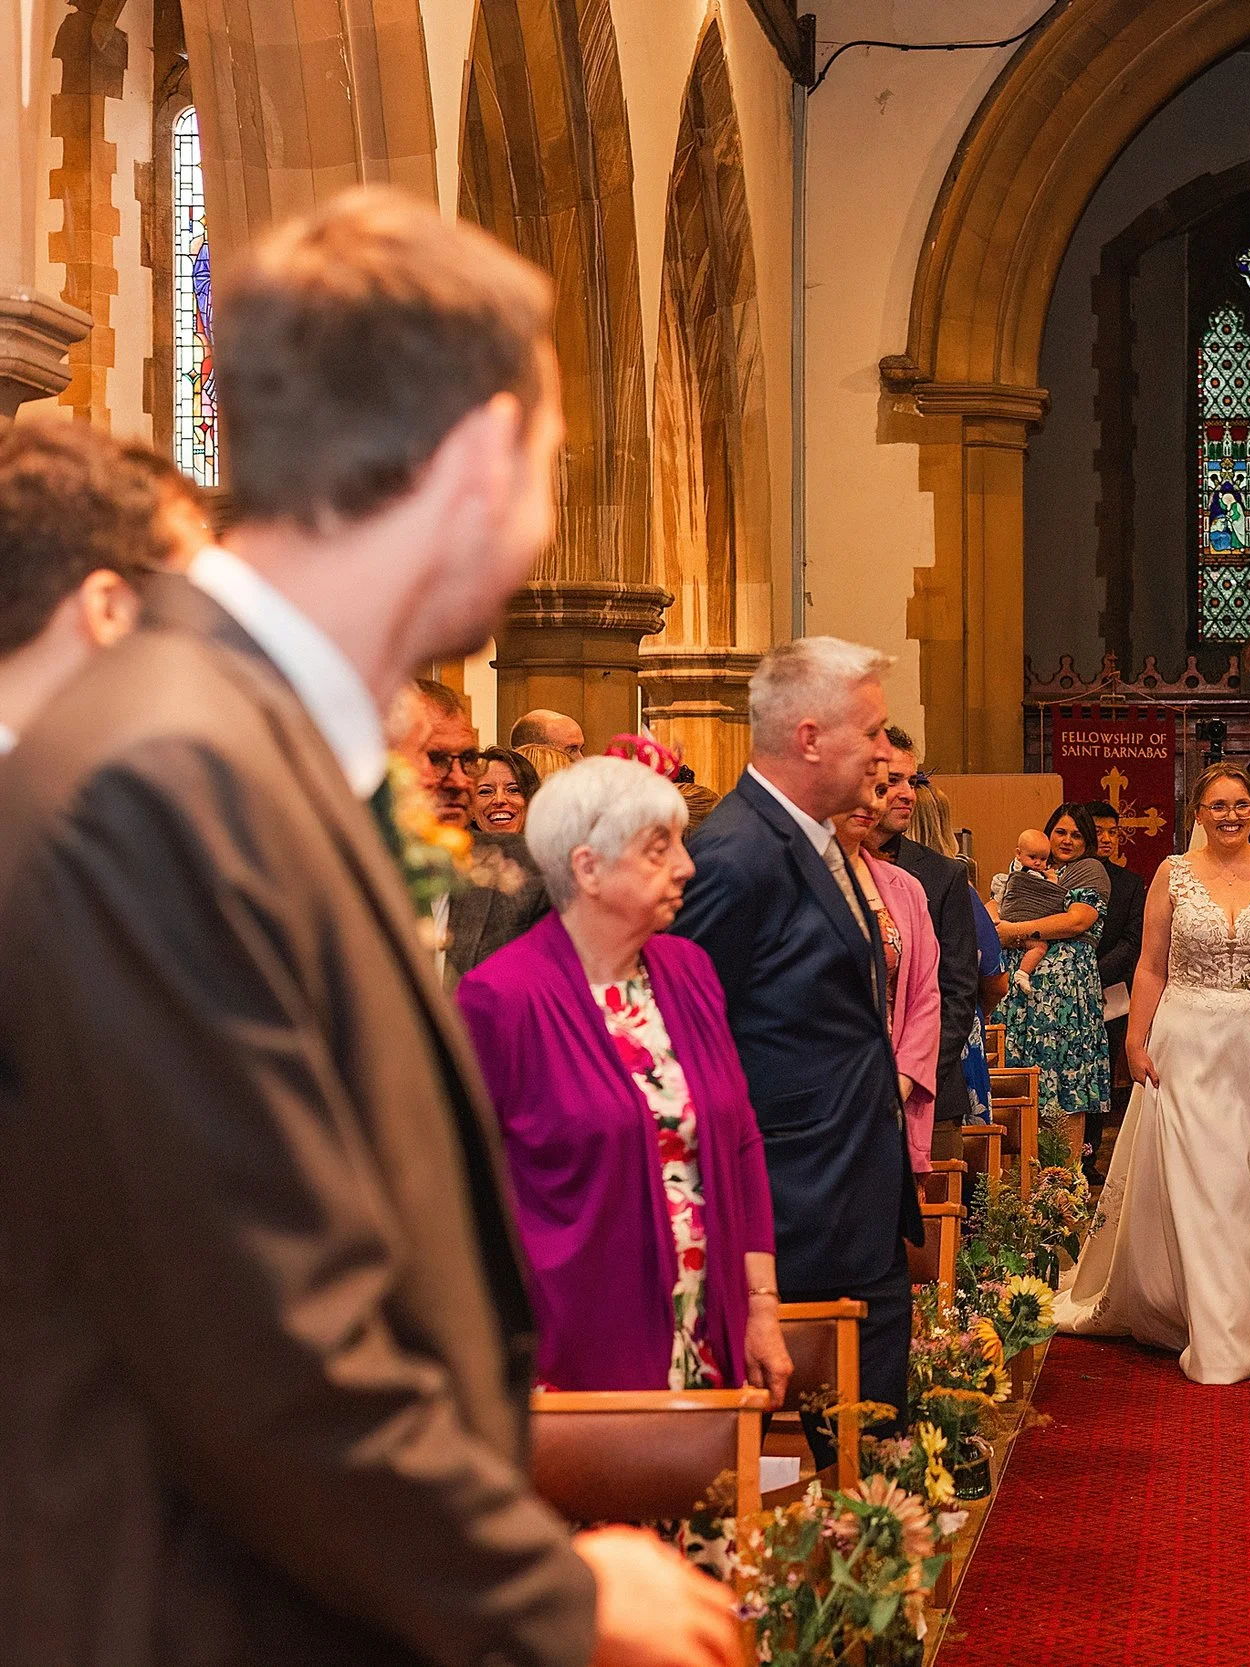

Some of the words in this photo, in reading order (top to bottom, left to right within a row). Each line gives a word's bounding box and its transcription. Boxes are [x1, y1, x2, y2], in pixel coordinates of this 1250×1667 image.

[1062, 731, 1144, 745] FELLOWSHIP
[1150, 733, 1167, 745] OF
[1062, 744, 1101, 757] SAINT
[1103, 746, 1168, 759] BARNABAS
